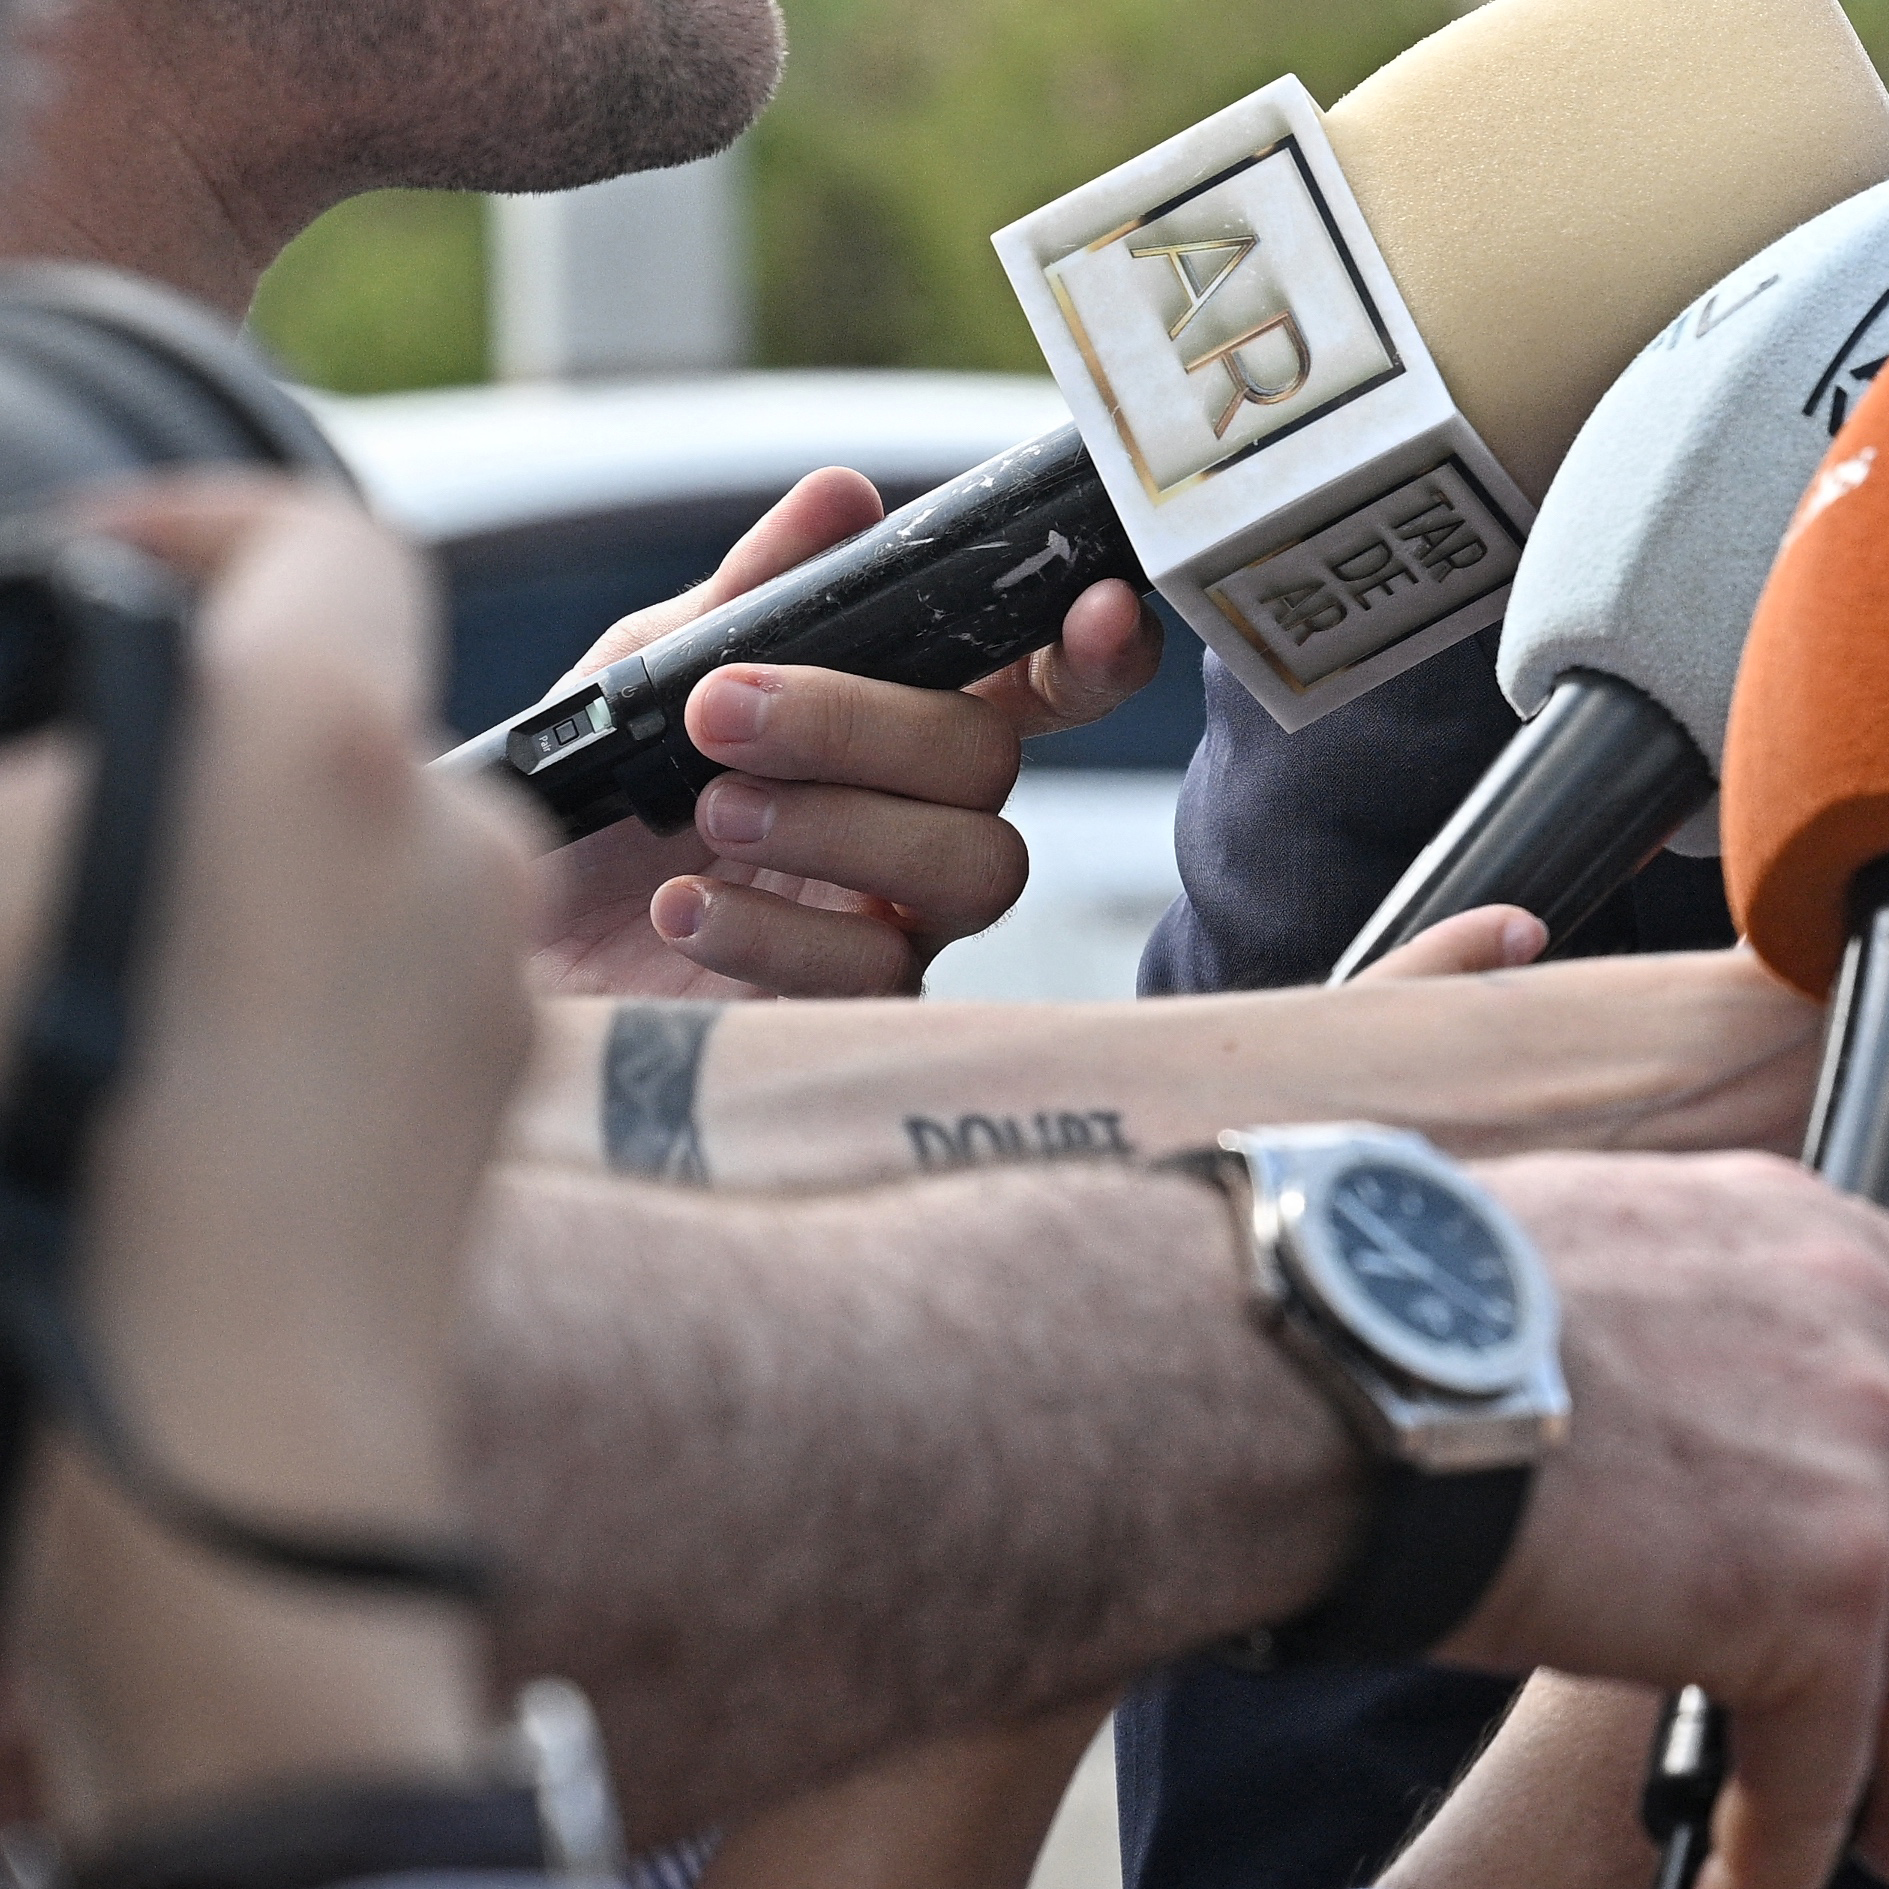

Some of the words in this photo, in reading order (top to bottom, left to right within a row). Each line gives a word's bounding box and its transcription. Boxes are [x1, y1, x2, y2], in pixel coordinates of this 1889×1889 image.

[1129, 234, 1312, 441] AR
[1391, 488, 1489, 584] TAR
[1329, 538, 1420, 612] DE
[1259, 580, 1349, 647] AR
[538, 734, 551, 753] Pair
